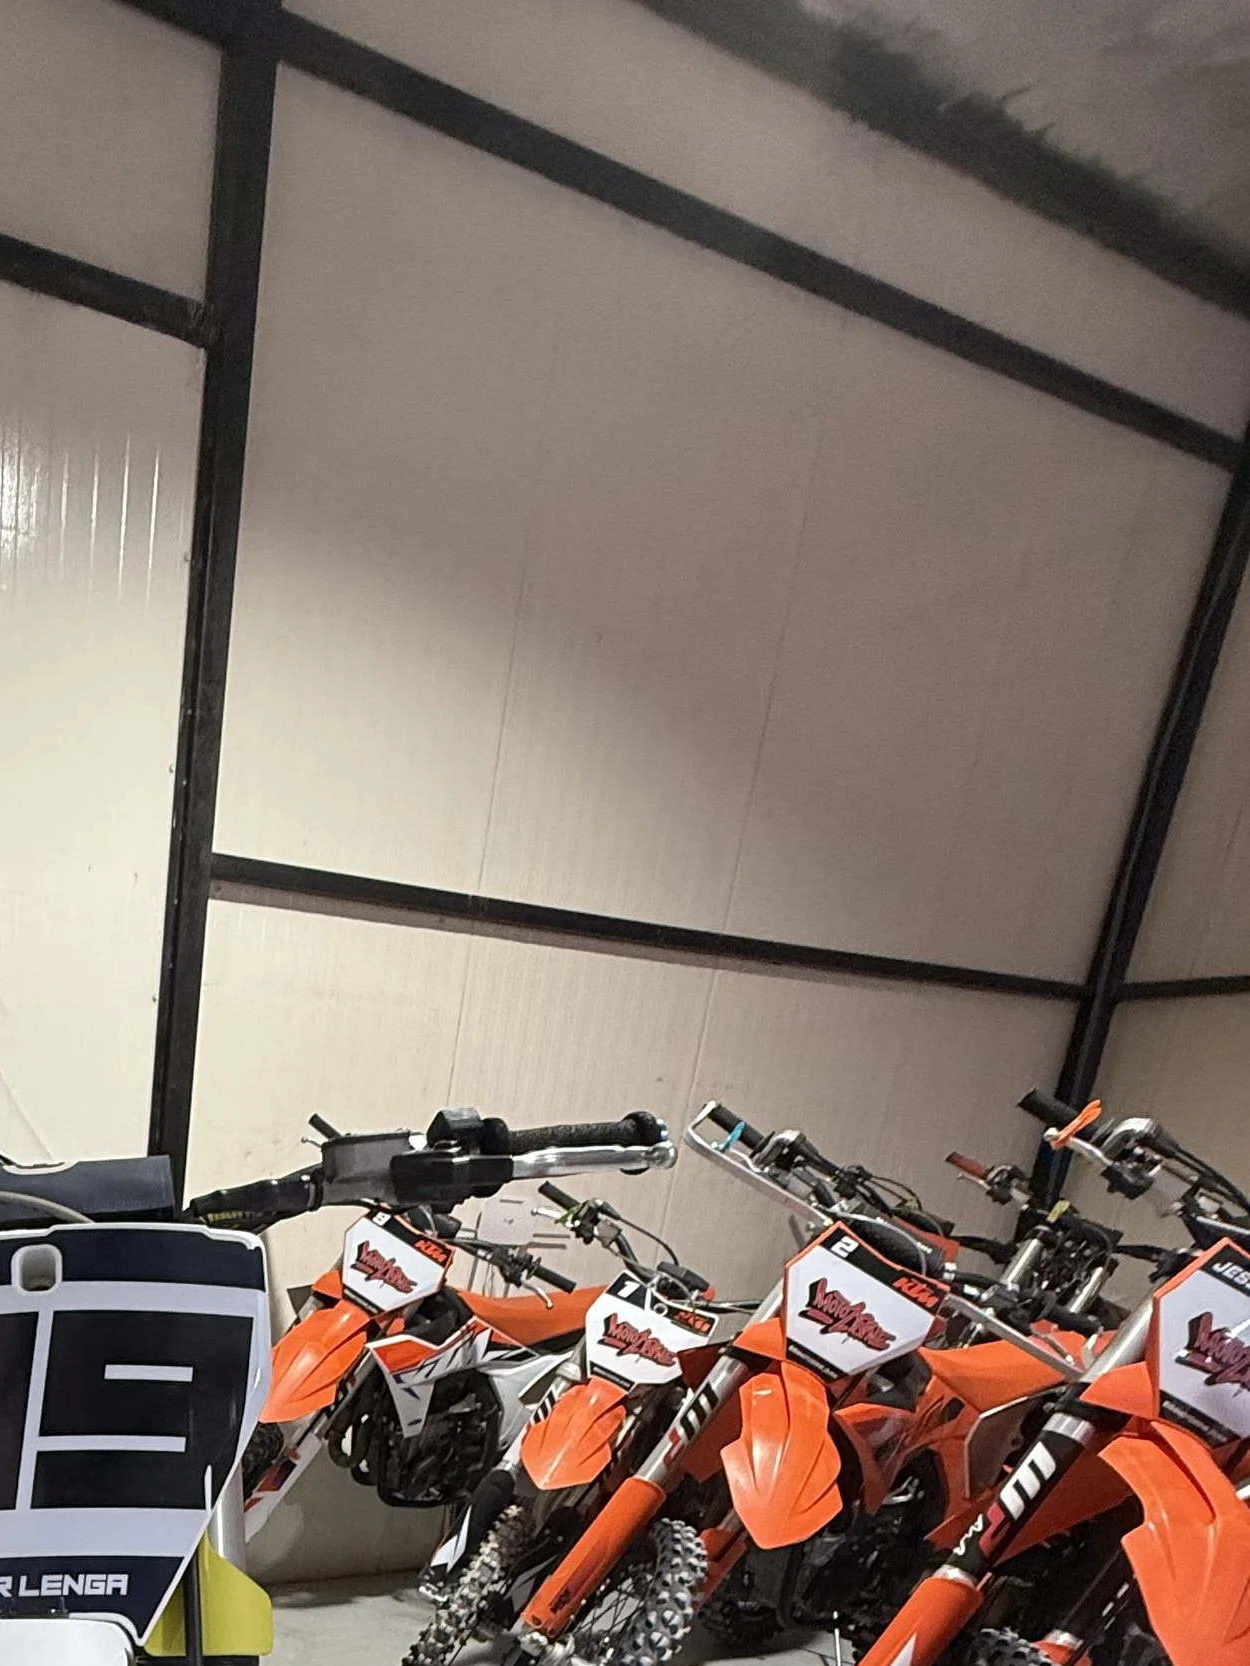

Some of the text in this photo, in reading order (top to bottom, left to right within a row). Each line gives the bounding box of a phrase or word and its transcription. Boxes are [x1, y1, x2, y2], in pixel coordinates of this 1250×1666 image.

[830, 1236, 860, 1258] 2
[617, 1281, 641, 1298] 1
[893, 1277, 939, 1308] KTM
[18, 1573, 129, 1597] LENGA
